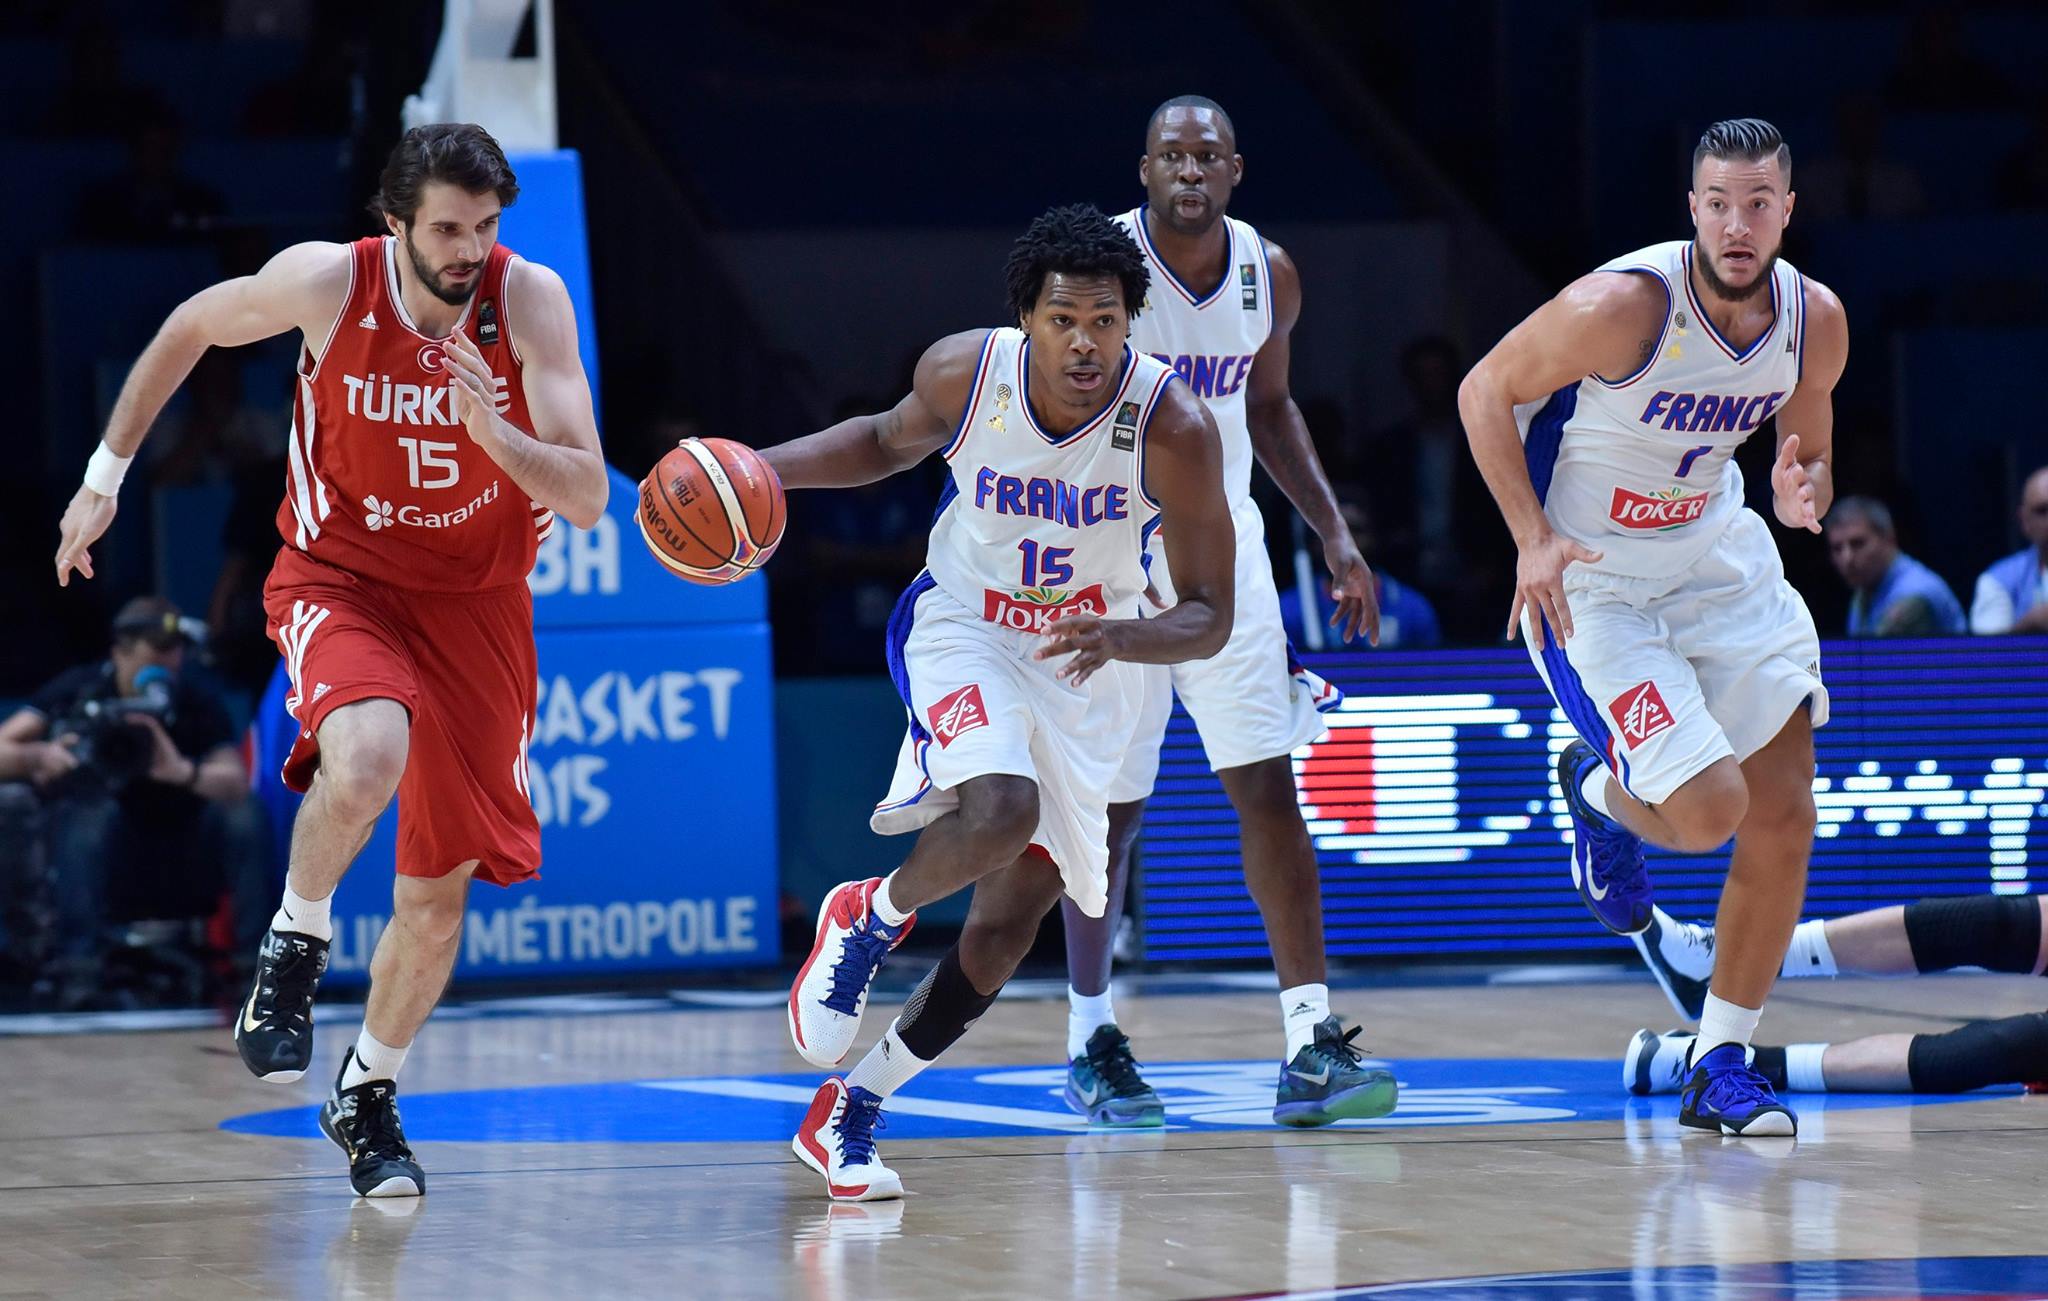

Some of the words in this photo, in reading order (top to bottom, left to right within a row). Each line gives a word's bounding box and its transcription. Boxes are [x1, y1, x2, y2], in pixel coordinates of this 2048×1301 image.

[480, 323, 496, 335] FIBA
[343, 373, 511, 426] TÜRKİE
[1116, 430, 1133, 441] FIBA
[398, 436, 460, 489] 15
[397, 480, 499, 528] Garanti
[643, 478, 687, 551] molten
[671, 476, 694, 507] FIBA
[975, 466, 1129, 529] FRANCE
[1616, 499, 1704, 522] JOKER
[527, 512, 620, 595] BA
[1018, 538, 1075, 587] 15
[530, 667, 743, 747] ASKET
[466, 895, 758, 966] MÉTROPOLE
